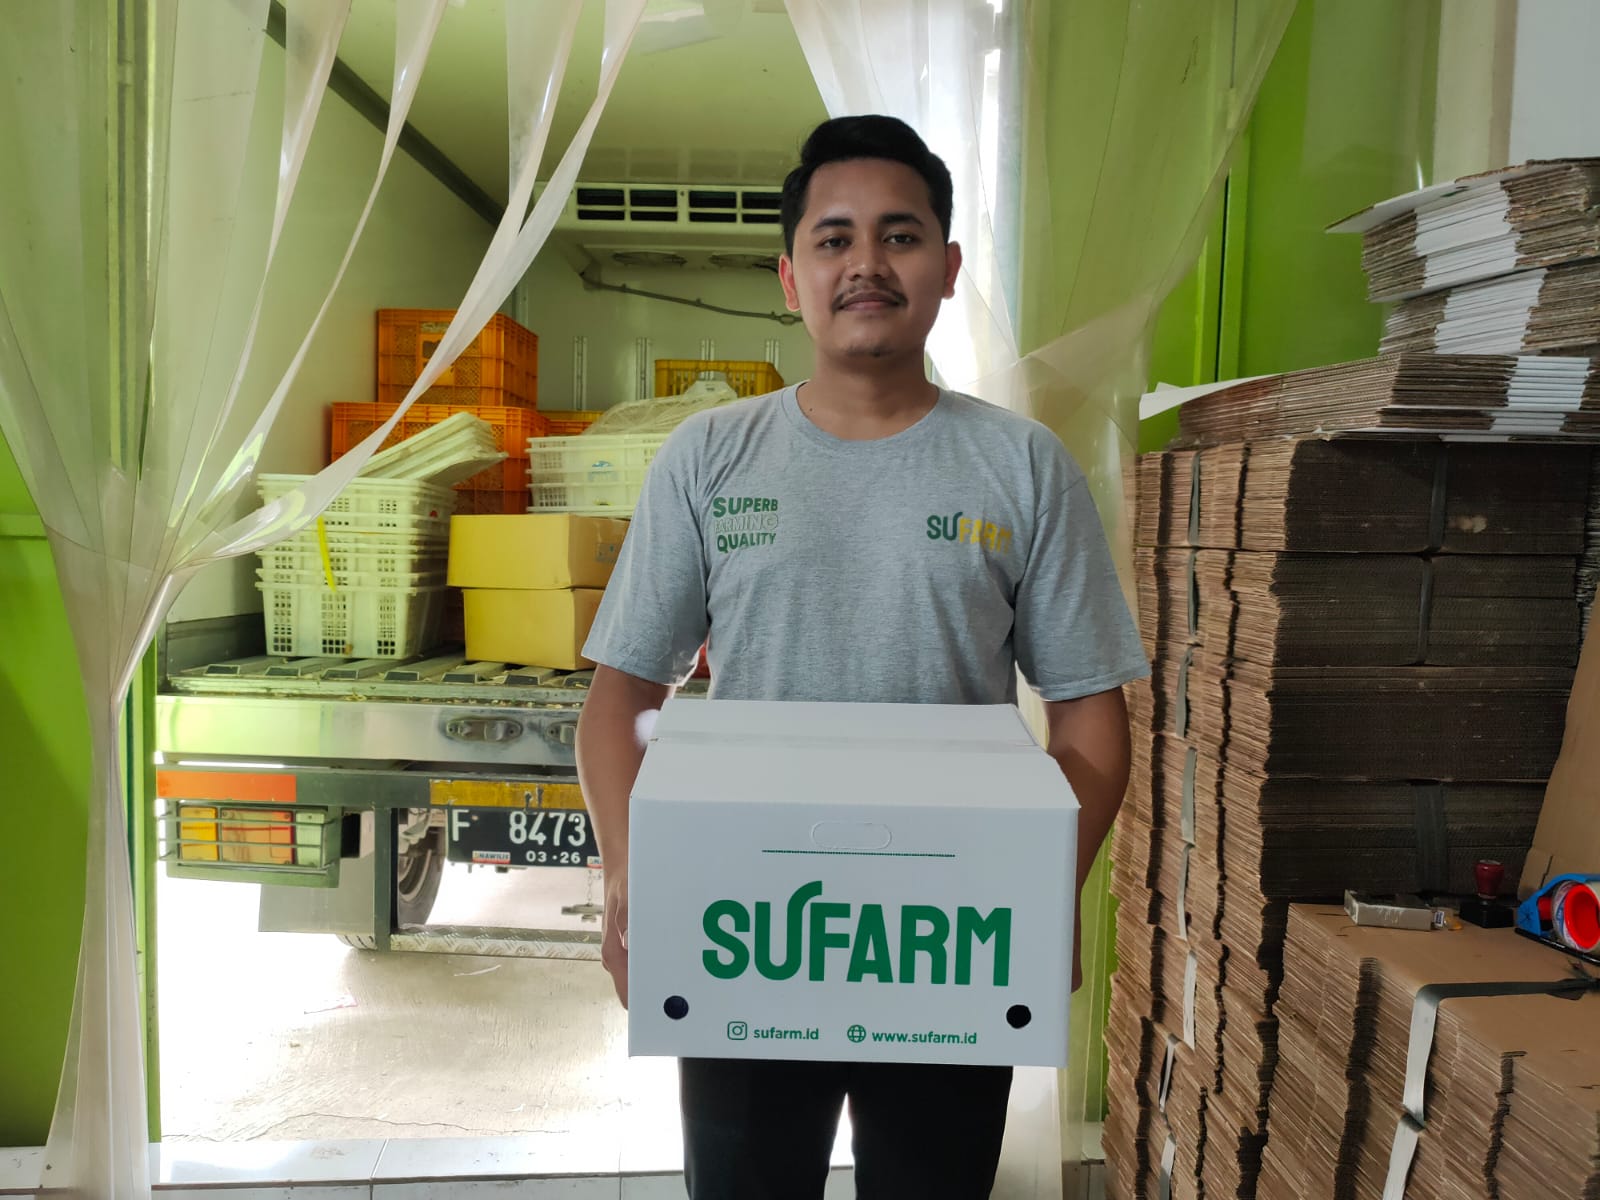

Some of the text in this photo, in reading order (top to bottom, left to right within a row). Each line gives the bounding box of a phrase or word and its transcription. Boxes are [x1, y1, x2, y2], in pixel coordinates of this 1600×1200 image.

[713, 497, 778, 517] SUPERB
[717, 533, 776, 553] QUALITY
[926, 511, 1012, 555] SUFARM
[452, 809, 586, 847] F 8473
[702, 880, 1012, 987] SUFARM
[753, 1026, 819, 1041] sufarm.id
[871, 1029, 977, 1045] www.sufarm.id
